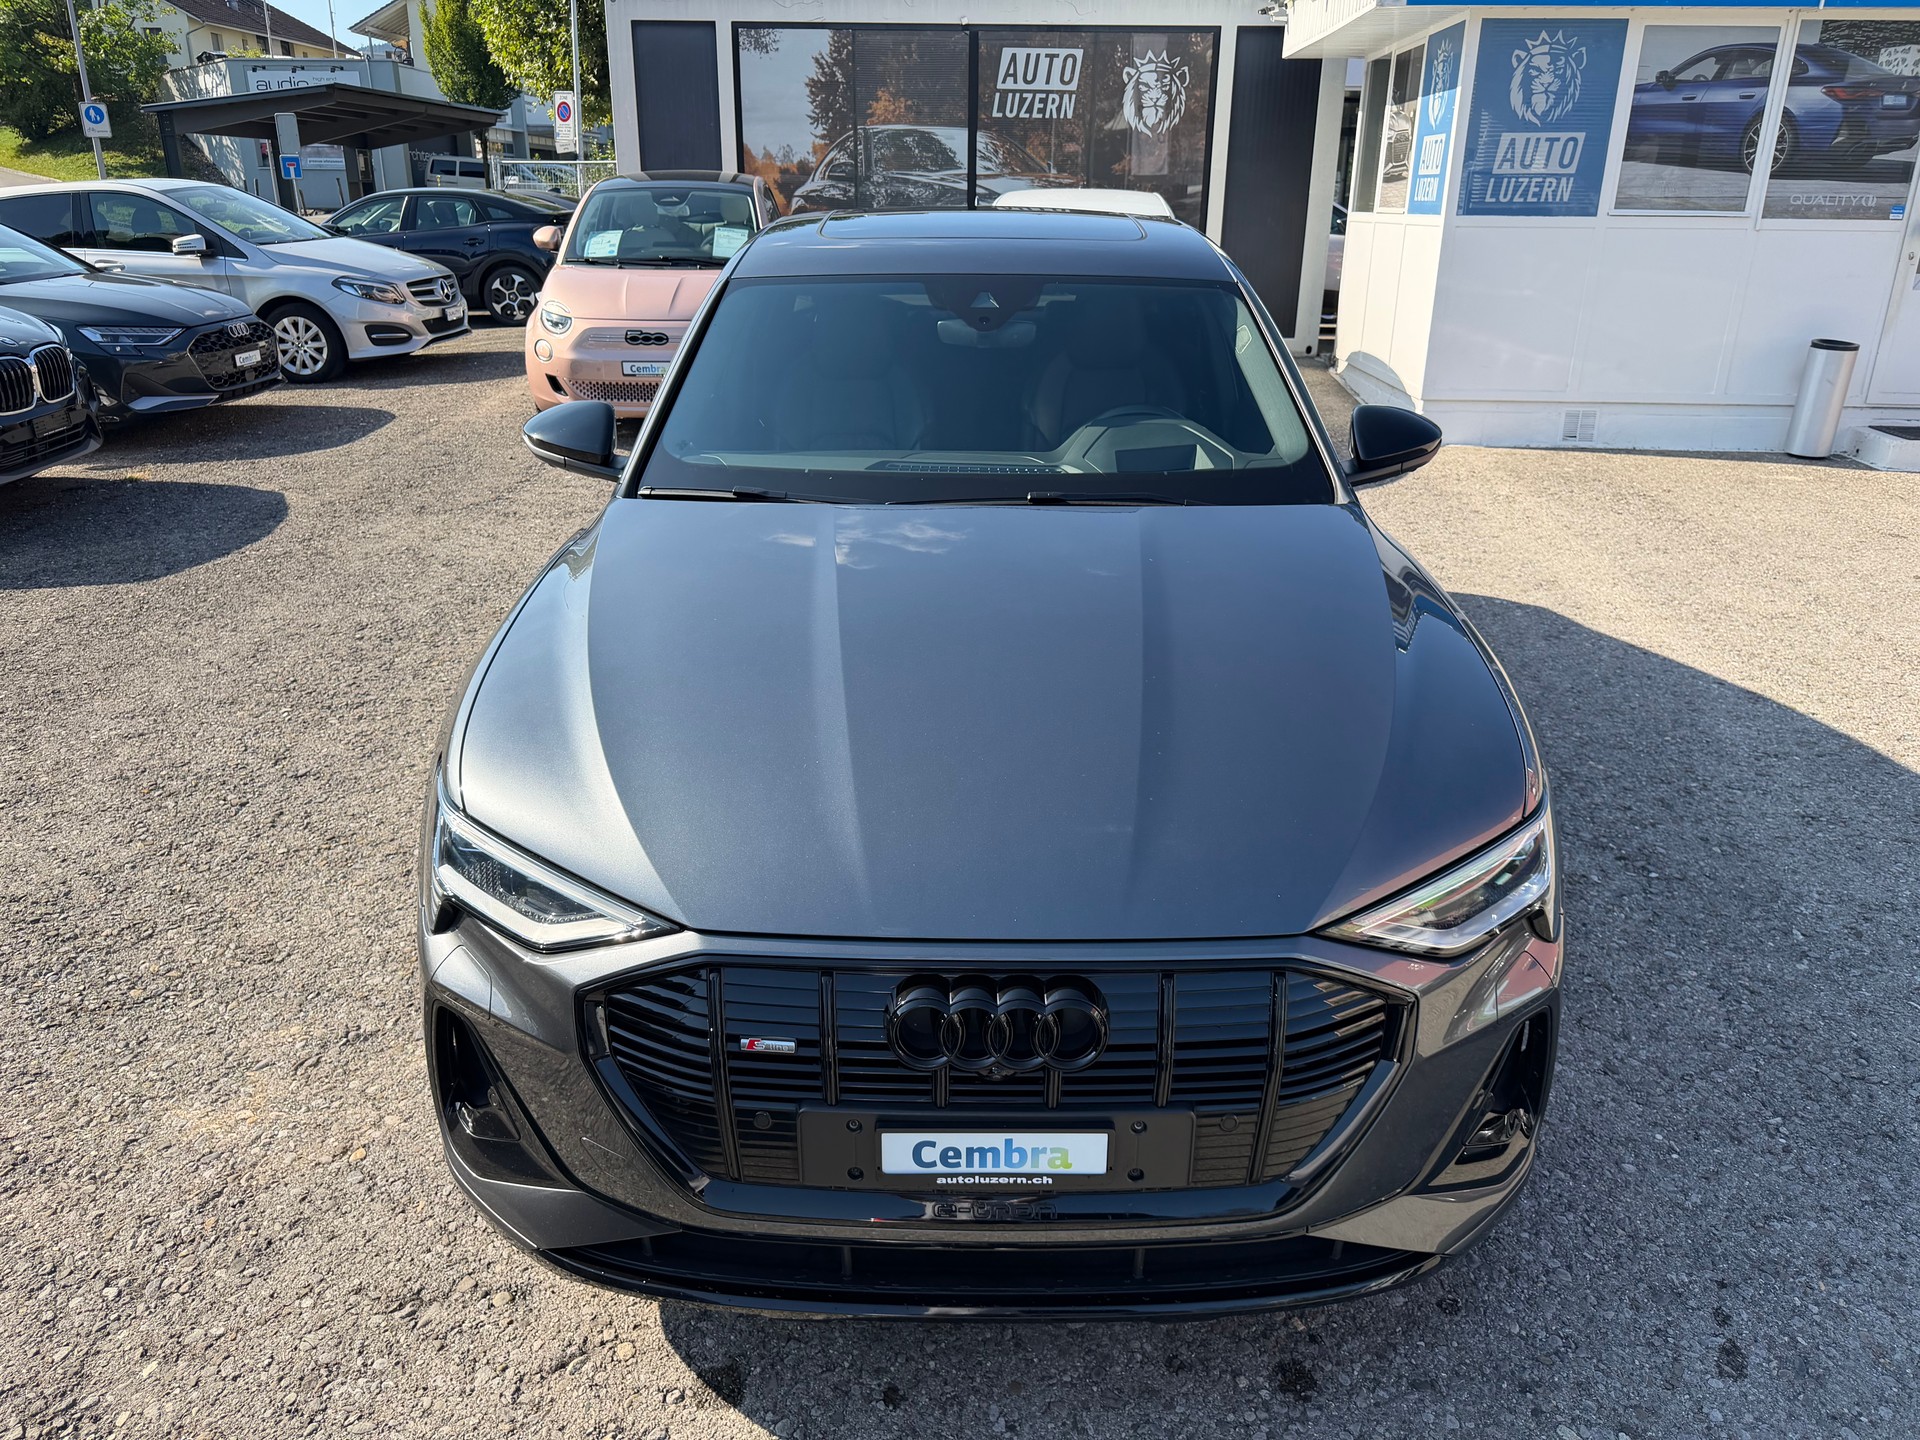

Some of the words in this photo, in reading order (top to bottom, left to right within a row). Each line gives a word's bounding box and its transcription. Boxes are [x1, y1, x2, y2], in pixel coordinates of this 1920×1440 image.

[1001, 52, 1078, 86] AUTO
[256, 76, 309, 91] audio
[992, 92, 1076, 119] LUZERN
[1421, 138, 1443, 170] AUTO
[1497, 136, 1579, 169] AUTO
[1414, 177, 1439, 202] LUZERN
[1485, 177, 1574, 203] LUZERN
[1790, 194, 1861, 207] QUALITY
[630, 364, 667, 373] Cembra
[912, 1138, 1073, 1170] Cembra
[936, 1175, 1053, 1185] autoluzern.ch
